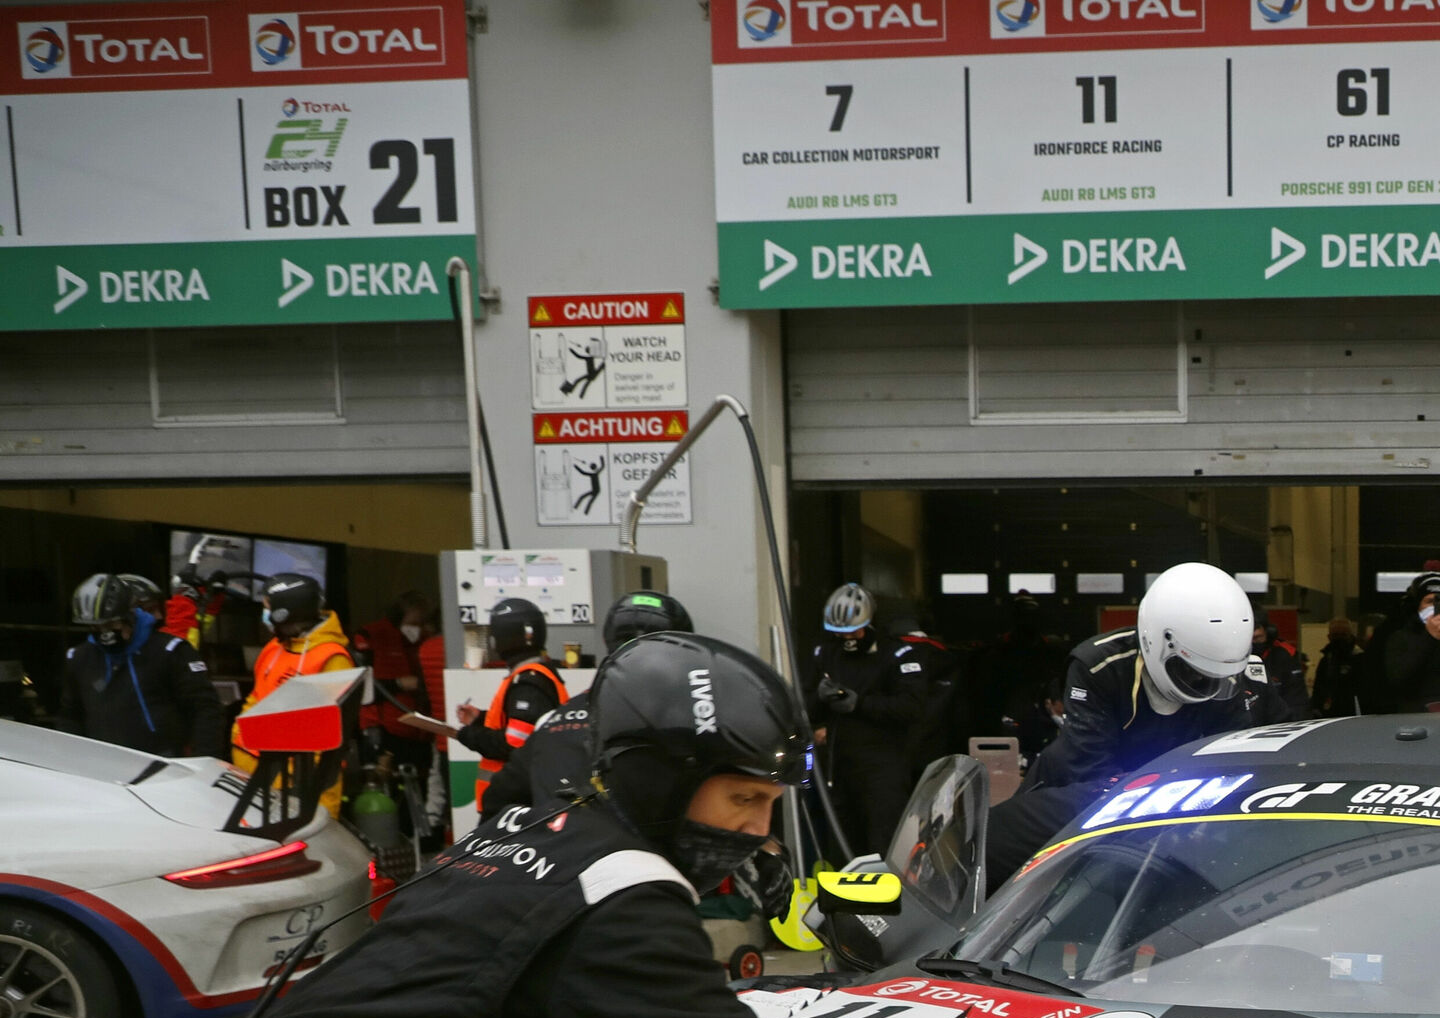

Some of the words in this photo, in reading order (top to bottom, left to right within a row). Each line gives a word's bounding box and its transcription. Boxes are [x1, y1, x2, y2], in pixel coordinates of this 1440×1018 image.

[797, 2, 938, 31] TOTAL
[73, 34, 204, 63] TOTAL
[305, 25, 438, 56] TOTAL
[1076, 75, 1118, 124] 11
[1336, 67, 1391, 117] 61
[301, 100, 352, 114] TOTAL
[825, 85, 854, 132] 7
[1034, 141, 1108, 156] IRONFORCE
[1113, 140, 1163, 154] RACING
[1327, 135, 1345, 149] CP
[1349, 133, 1401, 148] RACING
[742, 152, 769, 165] CAR
[773, 149, 849, 164] COLLECTION
[853, 147, 940, 162] MOTORSPORT
[368, 137, 459, 225] 21
[1281, 182, 1344, 197] PORSCHE
[1348, 182, 1373, 196] 991
[1376, 181, 1403, 195] CUP
[1408, 181, 1434, 195] GEN
[264, 185, 350, 228] BOX
[787, 197, 819, 210] AUDI
[822, 196, 840, 209] R8
[843, 195, 870, 208] LMS
[873, 194, 898, 207] GT3
[1042, 189, 1074, 203] AUDI
[1078, 188, 1096, 202] R8
[1100, 187, 1127, 201] LMS
[1130, 186, 1156, 200] GT3
[811, 242, 932, 280] DEKRA
[1062, 236, 1186, 274] DEKRA
[100, 268, 210, 304] DEKRA
[325, 261, 439, 297] DEKRA
[563, 301, 649, 321] CAUTION
[622, 336, 667, 348] WATCH
[609, 352, 644, 364] YOUR
[646, 351, 681, 363] HEAD
[559, 417, 664, 437] ACHTUNG
[460, 607, 476, 624] 21
[572, 604, 590, 623] 20
[687, 668, 718, 736] uvex
[1346, 804, 1385, 816] THE
[919, 985, 1012, 1018] TOTAL
